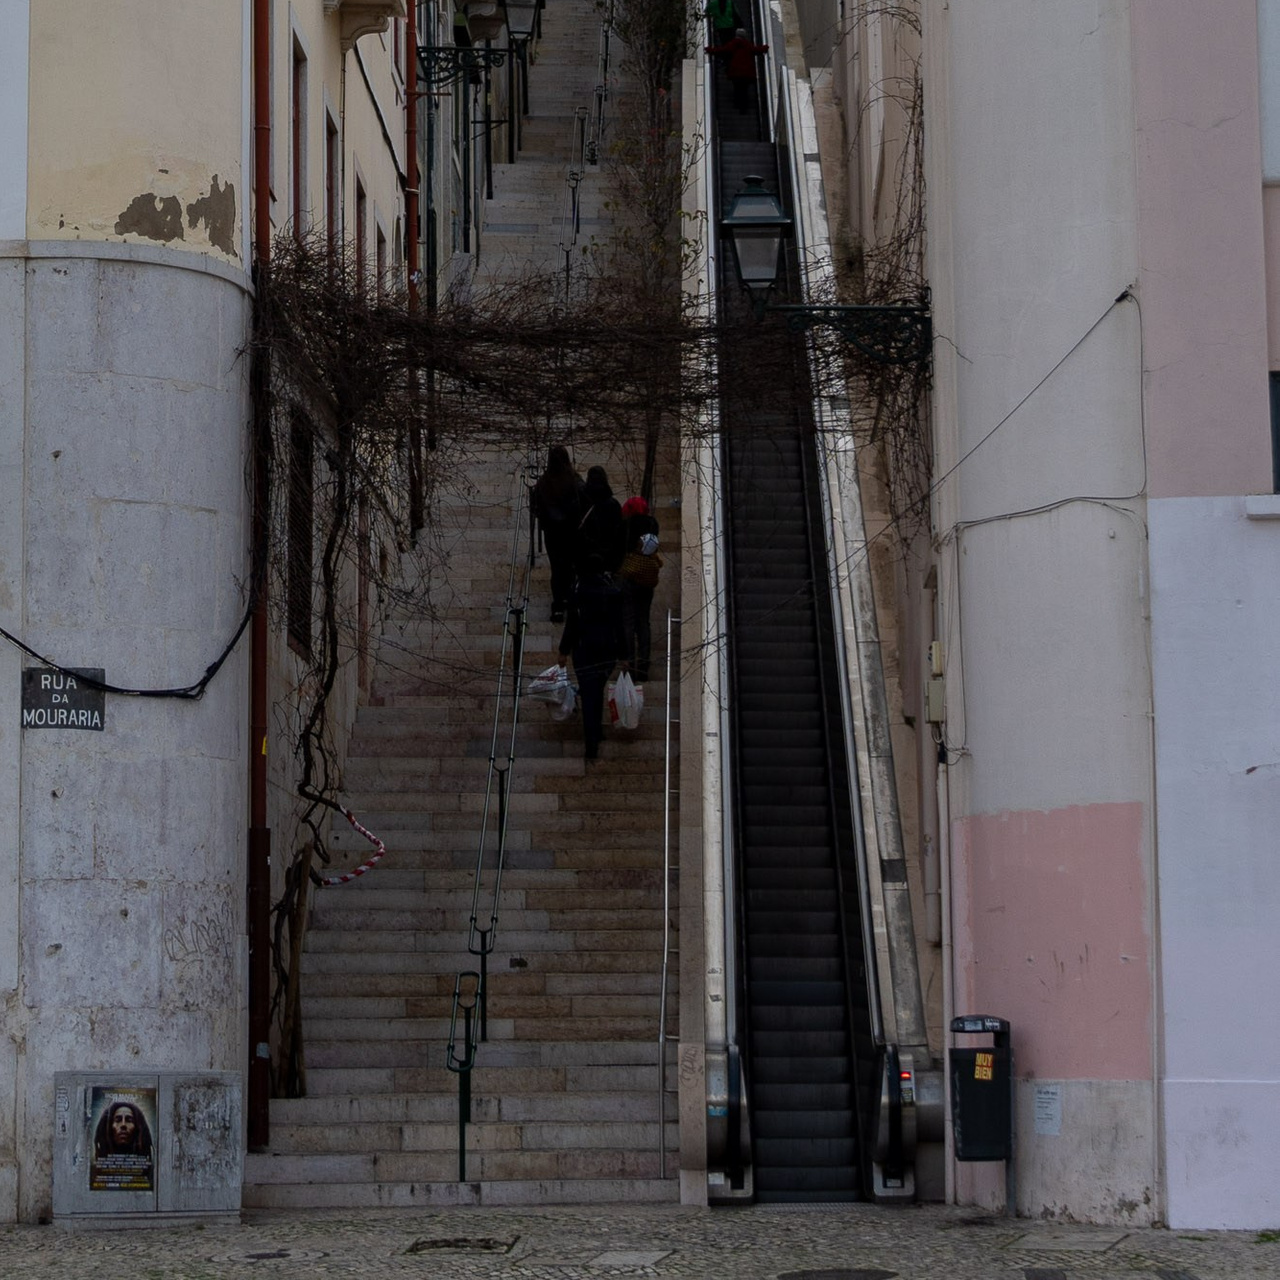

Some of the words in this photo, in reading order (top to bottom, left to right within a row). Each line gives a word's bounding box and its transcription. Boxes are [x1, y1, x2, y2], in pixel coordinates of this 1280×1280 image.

[41, 674, 77, 690] RUA
[52, 693, 69, 704] DA
[23, 708, 101, 728] MOURARIA
[976, 1053, 993, 1065] MUY
[974, 1067, 992, 1080] BIEN
